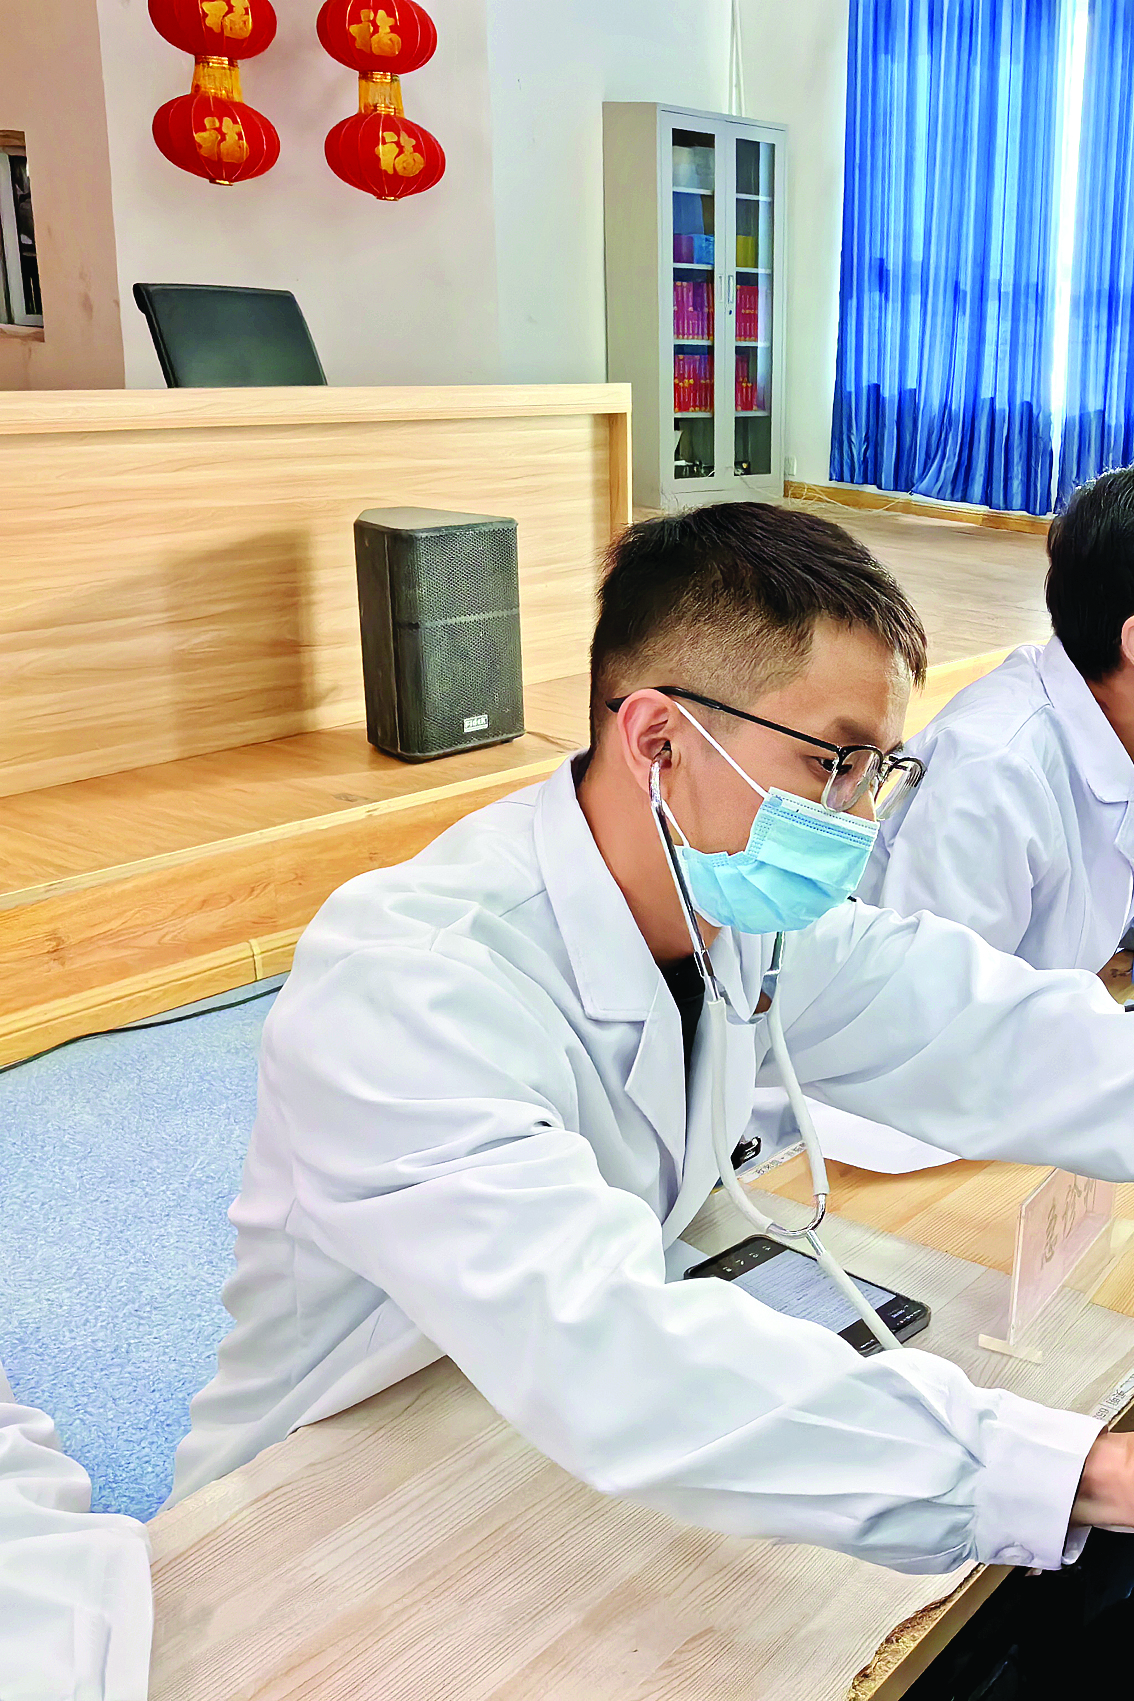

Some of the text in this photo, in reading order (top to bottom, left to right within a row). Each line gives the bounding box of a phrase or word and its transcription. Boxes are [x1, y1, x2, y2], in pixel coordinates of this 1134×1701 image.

[201, 0, 253, 39] 福
[349, 9, 402, 57] 福
[194, 116, 250, 164] 福
[374, 130, 426, 178] 福
